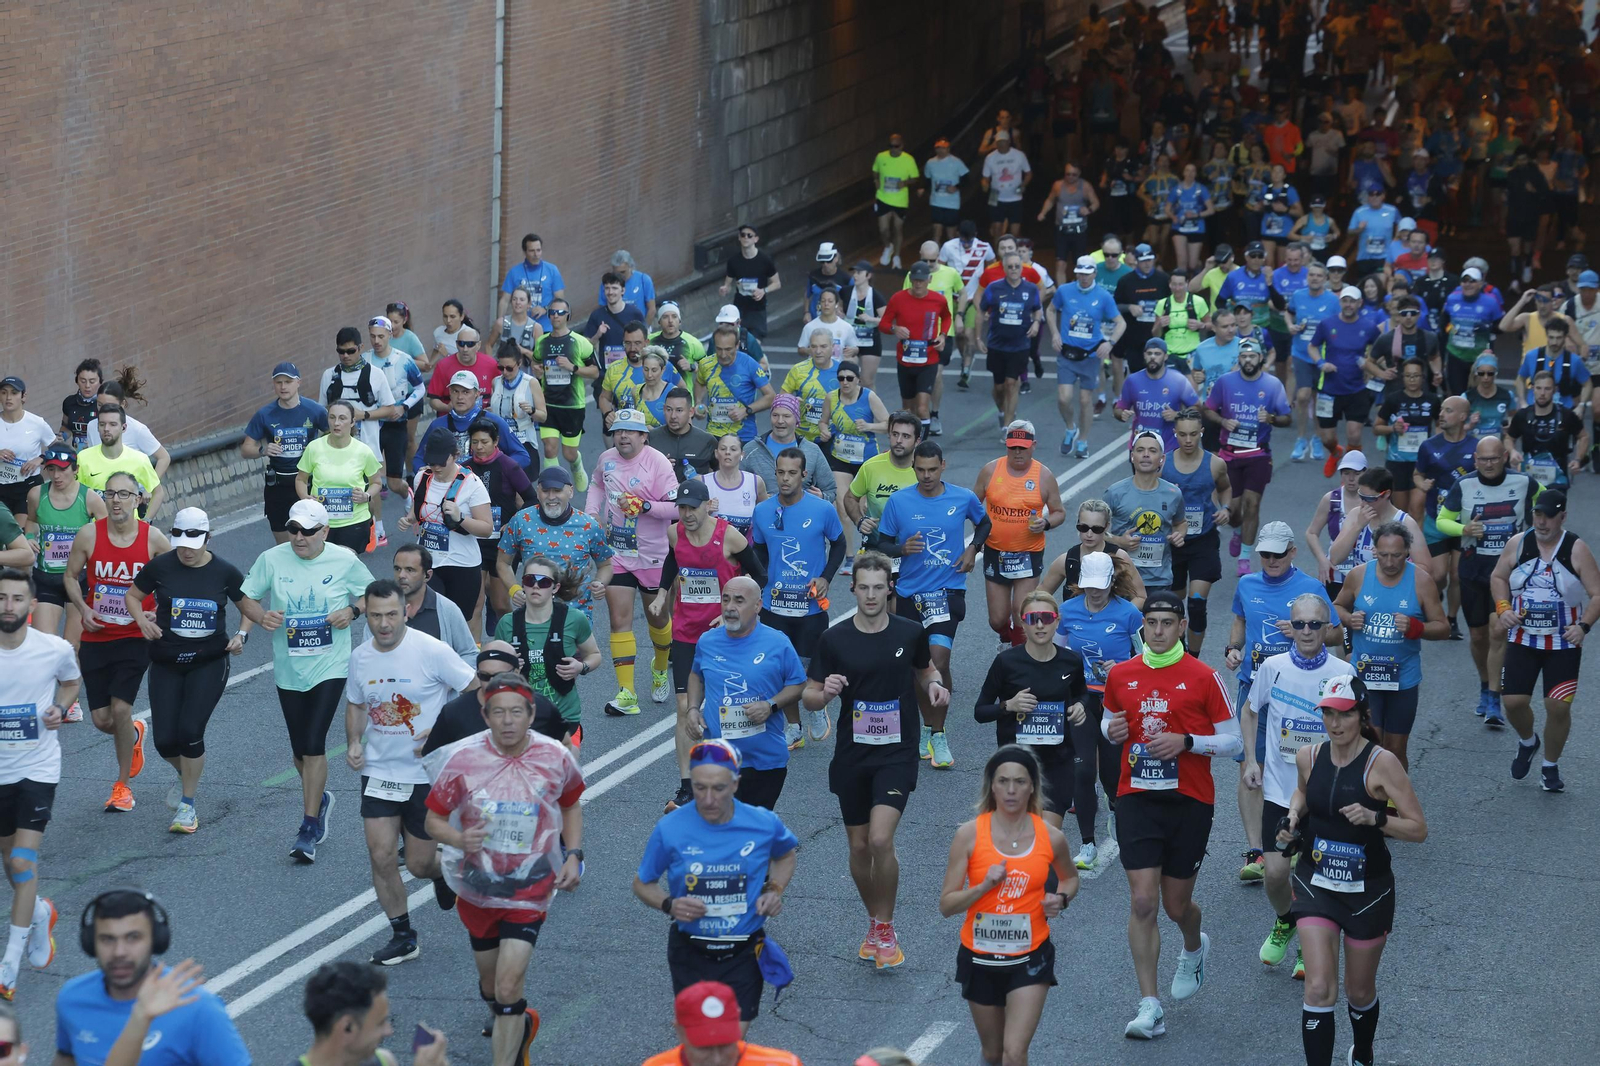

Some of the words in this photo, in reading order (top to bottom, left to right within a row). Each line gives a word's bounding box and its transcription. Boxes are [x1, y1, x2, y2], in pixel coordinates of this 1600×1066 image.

[281, 444, 303, 453] SPIDER
[324, 504, 352, 512] ORRAINE
[613, 540, 628, 549] KARL
[188, 600, 214, 608] ZURICH
[771, 600, 809, 609] GUILHERME
[181, 620, 207, 628] SONIA
[300, 618, 326, 626] ZURICH
[299, 638, 321, 646] PACO
[1365, 673, 1391, 681] CESAR
[734, 696, 760, 704] ZURICH
[865, 724, 888, 734] JOSH
[1022, 724, 1057, 734] MARIKA
[1280, 745, 1299, 754] CARMEL
[1141, 768, 1164, 778] ALEX
[380, 780, 402, 790] ABEL
[492, 828, 524, 844] JORGE
[1331, 844, 1360, 855] ZURICH
[1328, 858, 1348, 868] 14343
[706, 864, 740, 873] ZURICH
[1322, 866, 1353, 881] NADIA
[1005, 876, 1027, 888] RUN
[1001, 888, 1022, 899] FUN
[715, 893, 746, 904] RESISTE
[698, 920, 734, 929] SEVILLA
[975, 928, 1029, 940] FILOMENA
